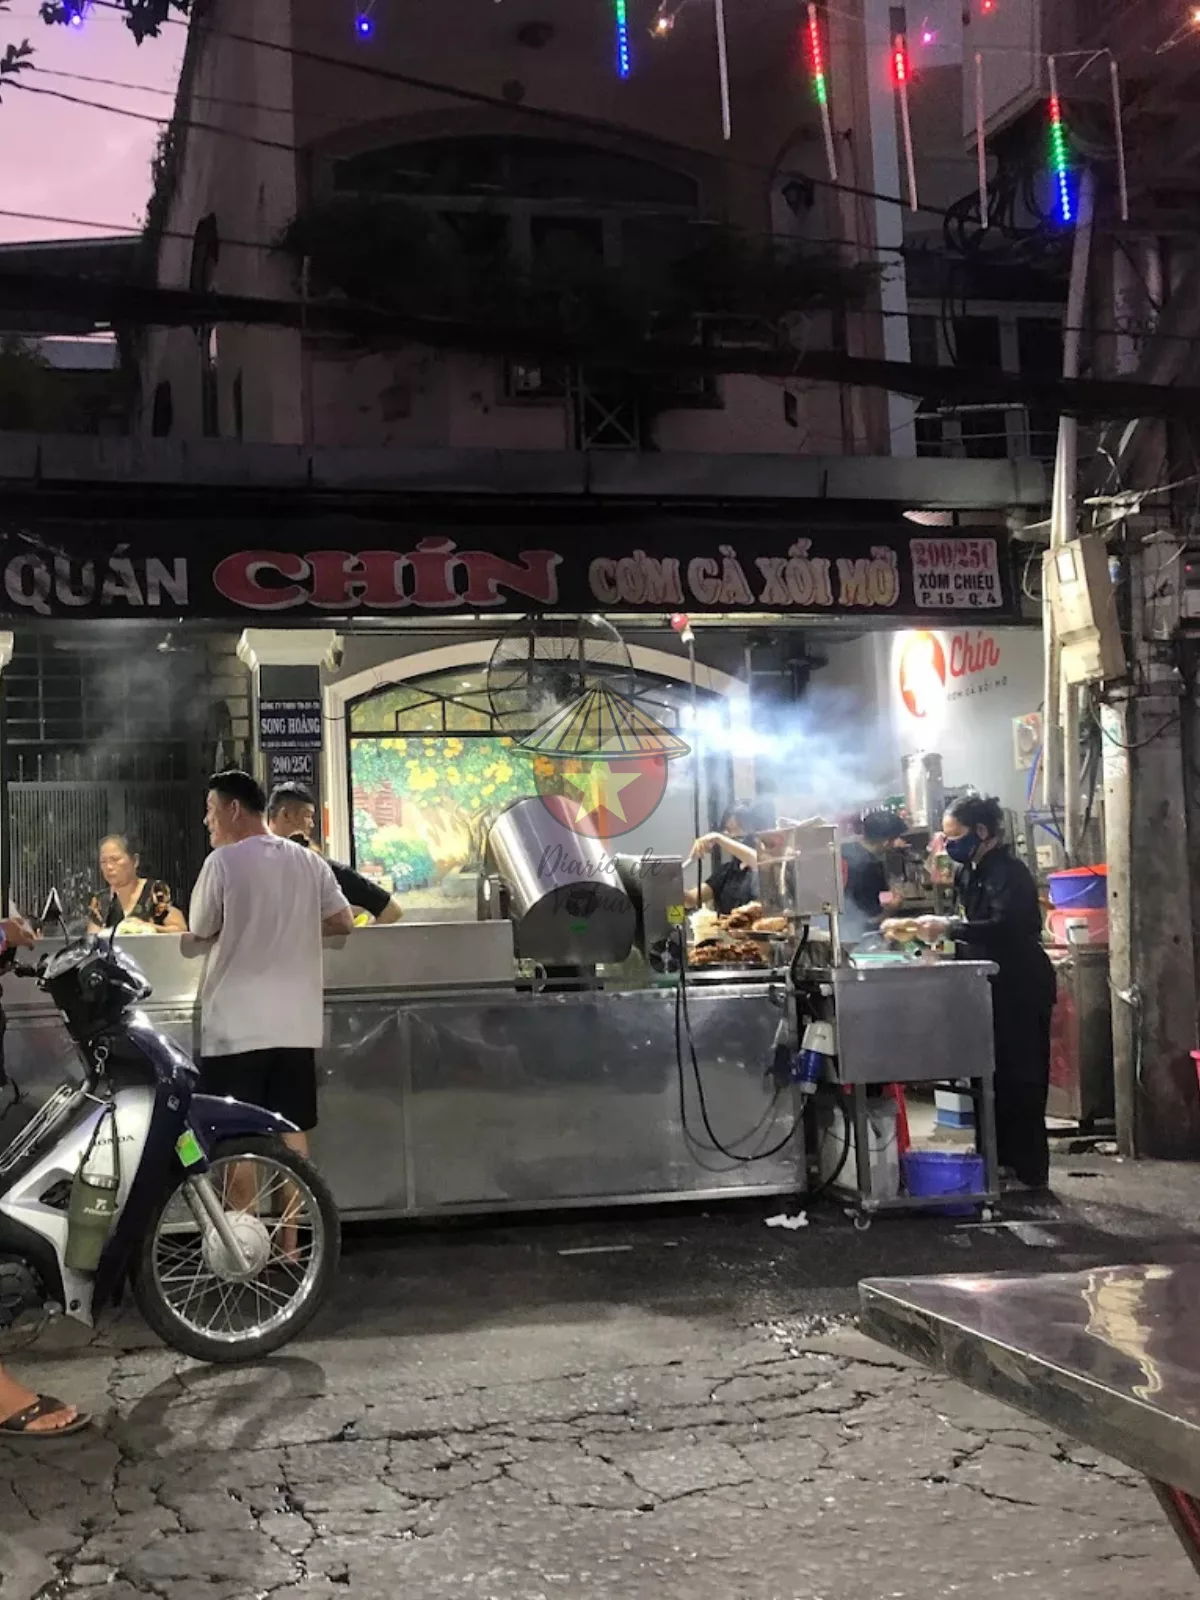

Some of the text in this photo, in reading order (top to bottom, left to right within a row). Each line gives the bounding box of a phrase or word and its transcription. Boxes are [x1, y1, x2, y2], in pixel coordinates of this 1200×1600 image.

[3, 543, 190, 616] QUÁN
[212, 536, 564, 611] CHÍN
[588, 549, 685, 605] CƠM
[687, 544, 755, 605] GÀ
[261, 718, 286, 734] SONG
